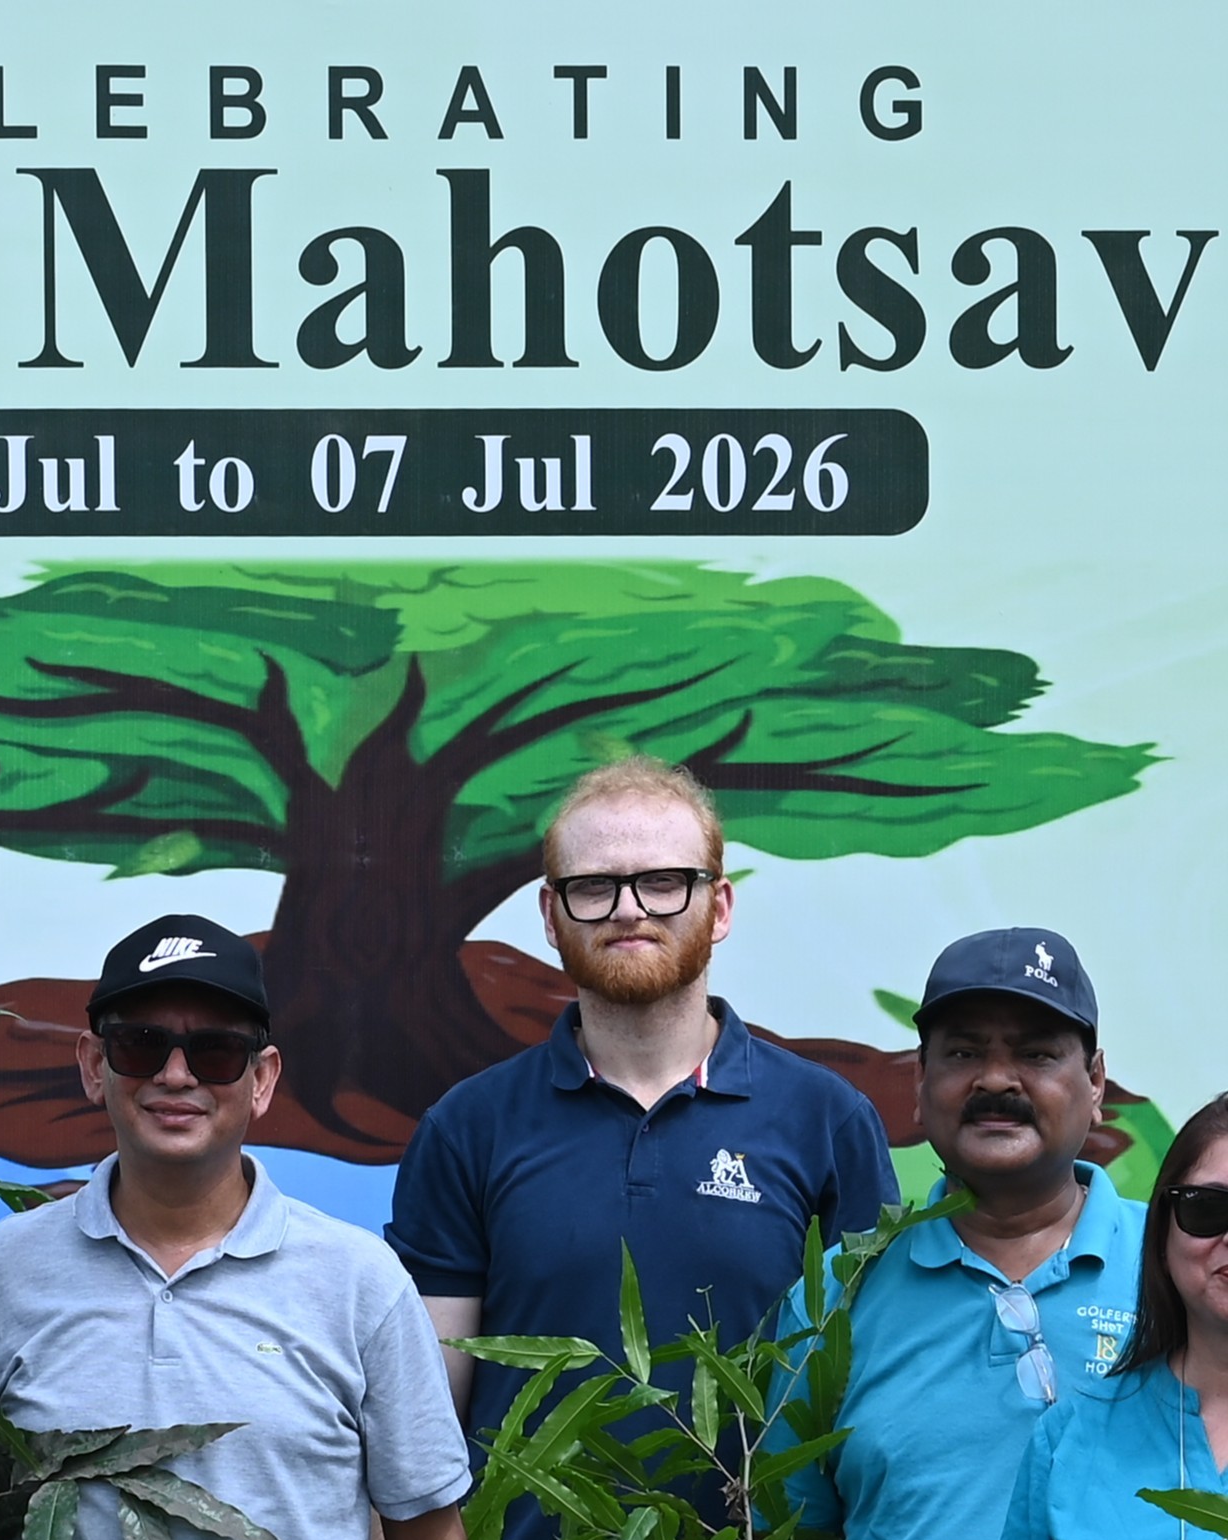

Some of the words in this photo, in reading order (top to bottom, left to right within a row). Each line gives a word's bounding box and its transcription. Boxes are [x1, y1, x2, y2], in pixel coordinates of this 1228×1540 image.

[15, 167, 1220, 373] Mahotsav
[173, 440, 255, 513] to
[310, 434, 408, 513] 07
[461, 434, 597, 513] Jul
[650, 434, 850, 513] 2026
[151, 937, 203, 959] NIKE
[1024, 965, 1059, 988] POLO
[1091, 1318, 1125, 1334] SHOT
[1095, 1334, 1119, 1361] 18
